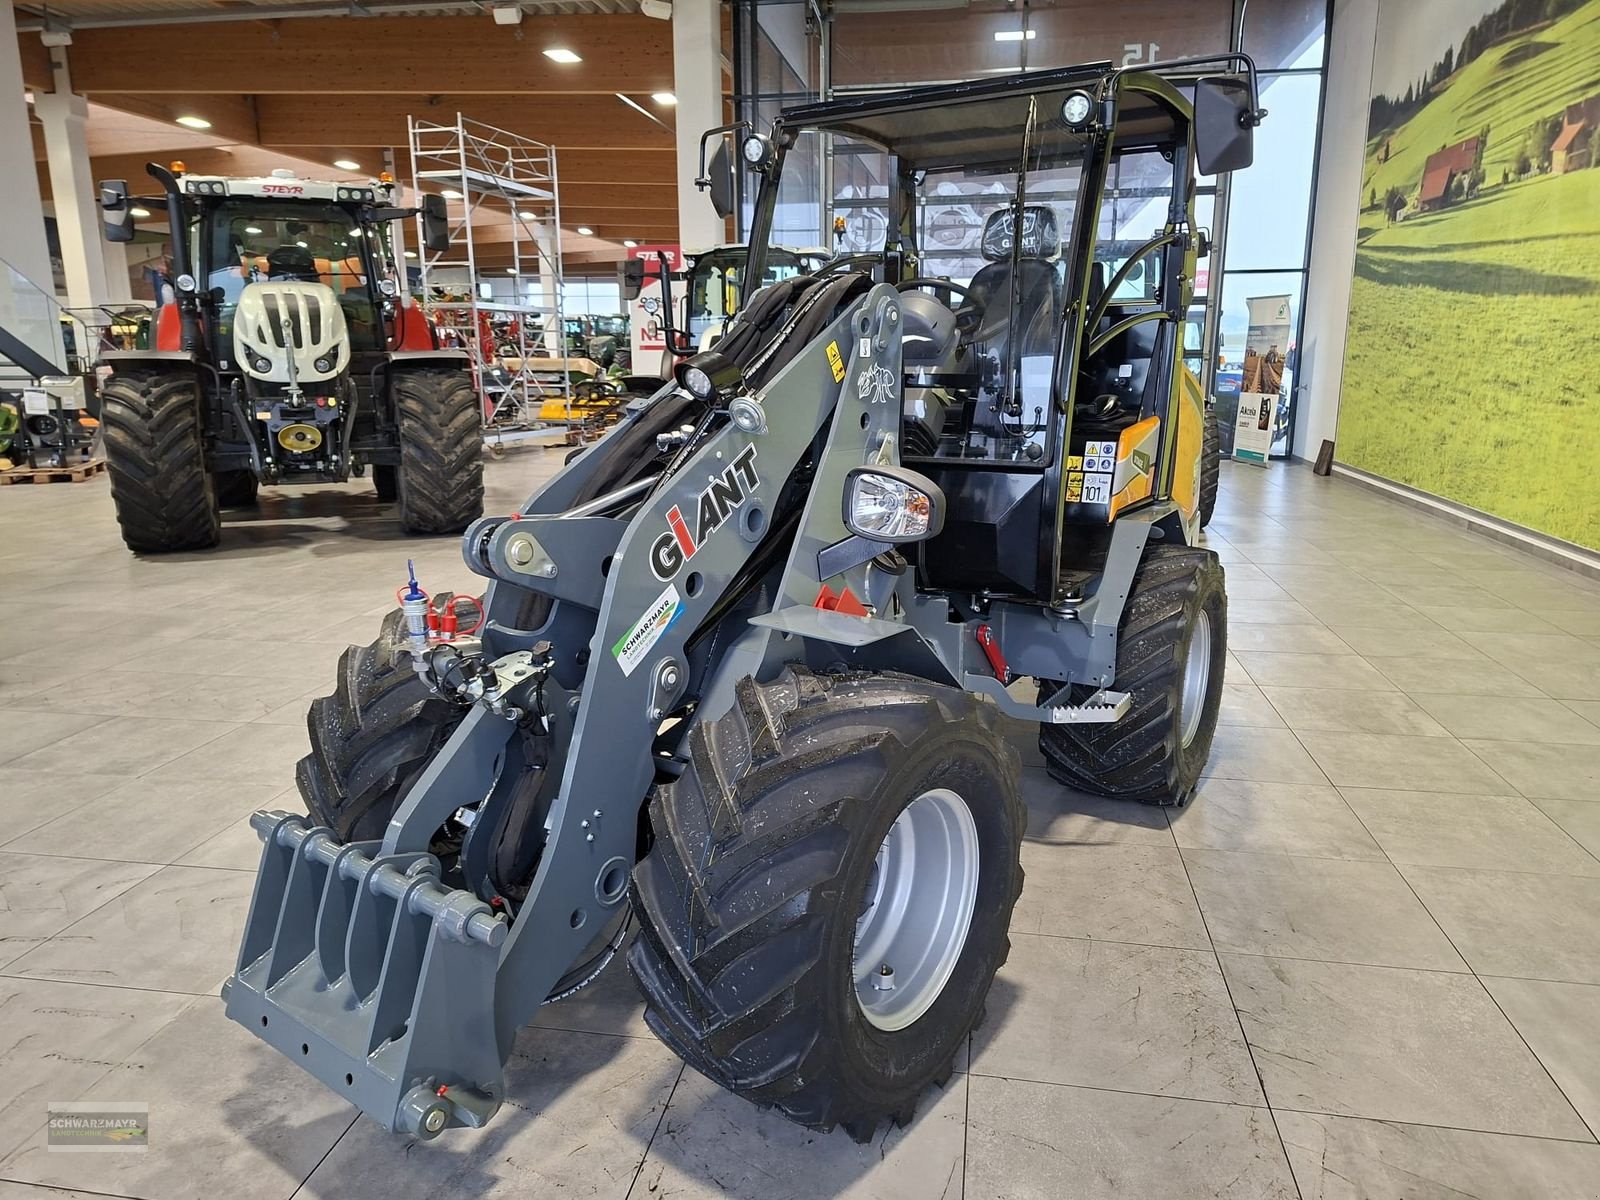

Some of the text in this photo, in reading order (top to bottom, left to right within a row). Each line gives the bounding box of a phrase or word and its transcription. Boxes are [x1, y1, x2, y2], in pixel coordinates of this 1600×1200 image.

[262, 185, 304, 195] STEYR
[1002, 236, 1036, 248] GNT
[636, 251, 675, 261] STER
[1085, 486, 1101, 502] 101
[622, 600, 670, 655] SCHWARZMAYR
